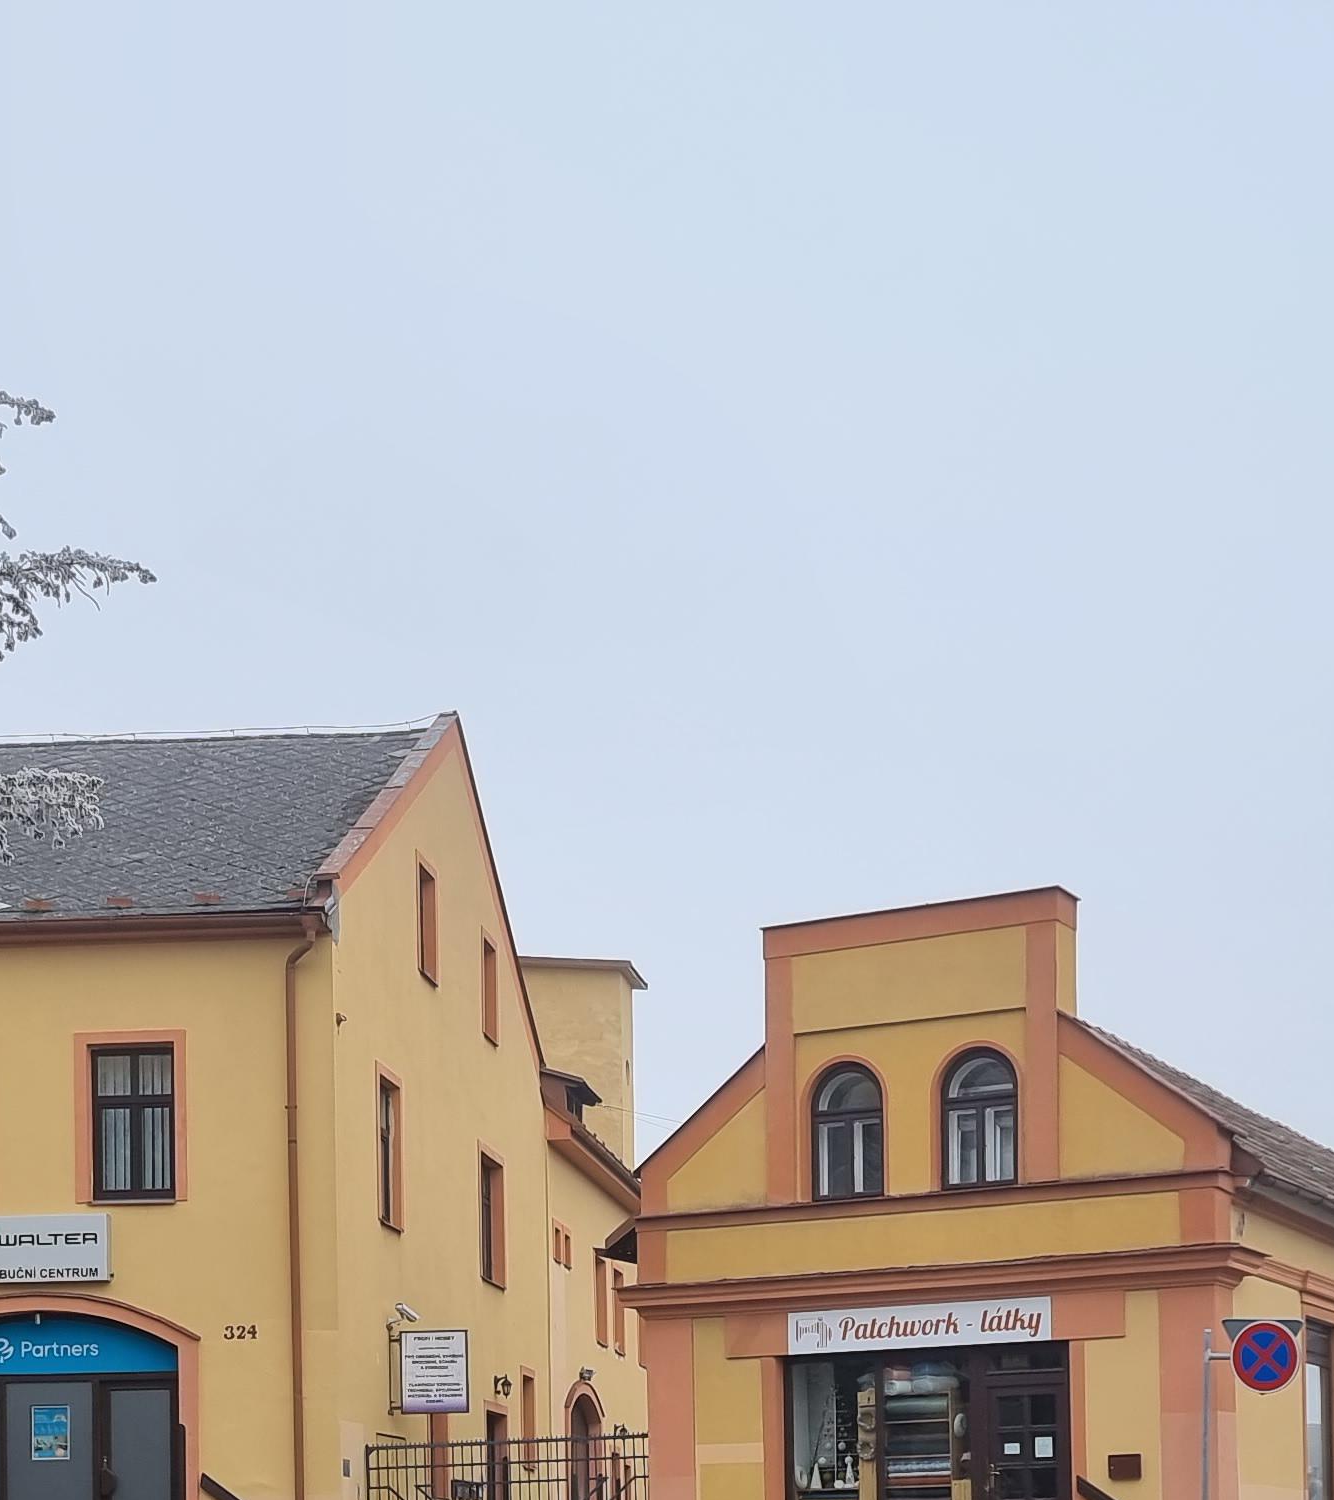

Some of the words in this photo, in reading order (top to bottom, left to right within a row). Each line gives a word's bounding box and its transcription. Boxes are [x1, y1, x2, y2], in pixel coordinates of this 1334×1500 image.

[39, 1267, 99, 1279] CENTRUM
[838, 1312, 960, 1341] Patchwork
[979, 1306, 1043, 1338] látky
[223, 1324, 258, 1340] 324
[20, 1341, 99, 1358] Partners
